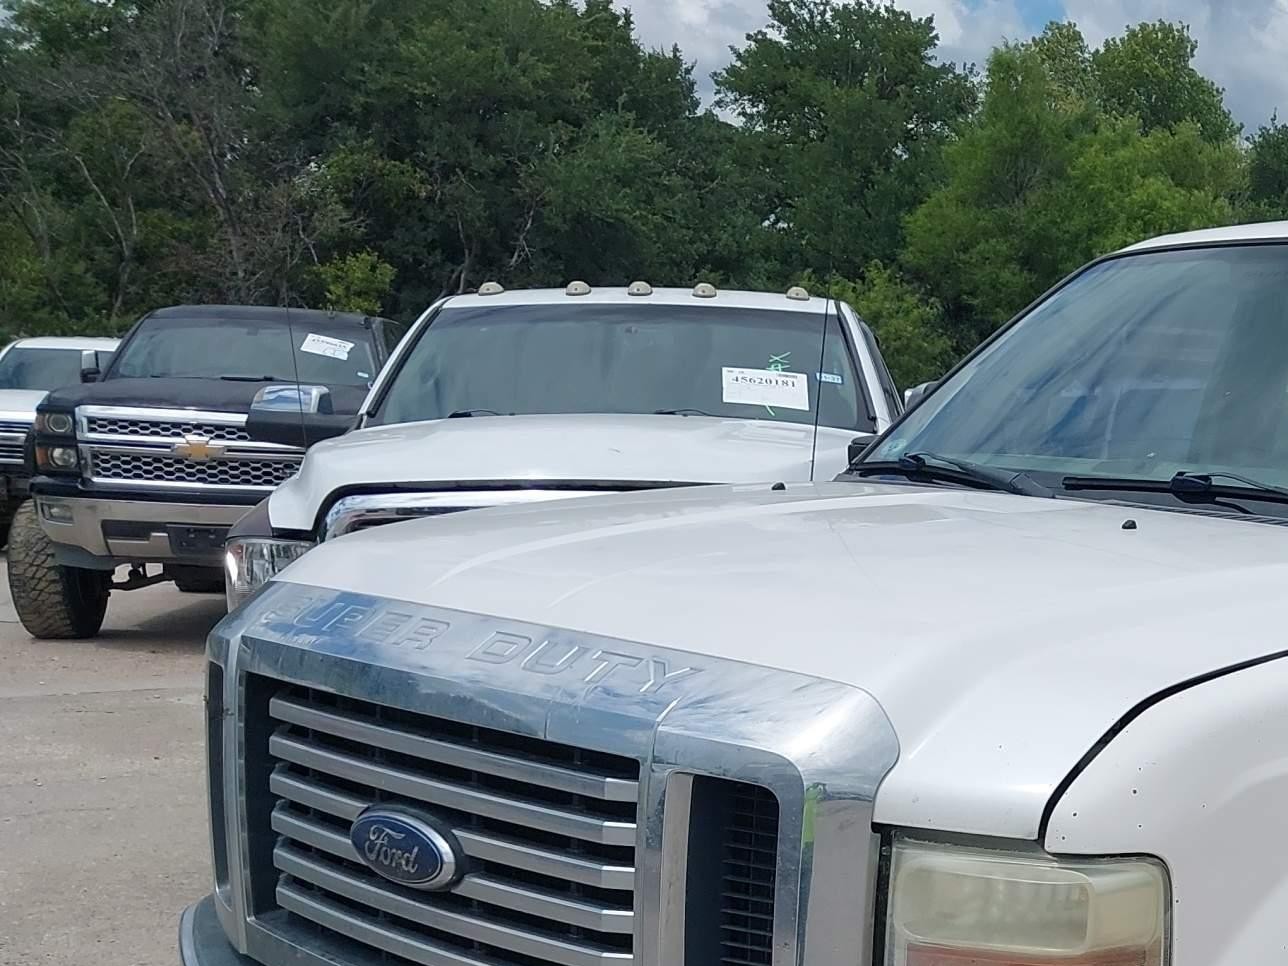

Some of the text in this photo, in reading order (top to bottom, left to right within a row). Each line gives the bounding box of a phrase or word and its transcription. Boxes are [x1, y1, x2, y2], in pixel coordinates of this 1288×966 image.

[731, 375, 796, 388] 45620181
[464, 630, 704, 694] DUTY
[364, 824, 420, 874] Ford
